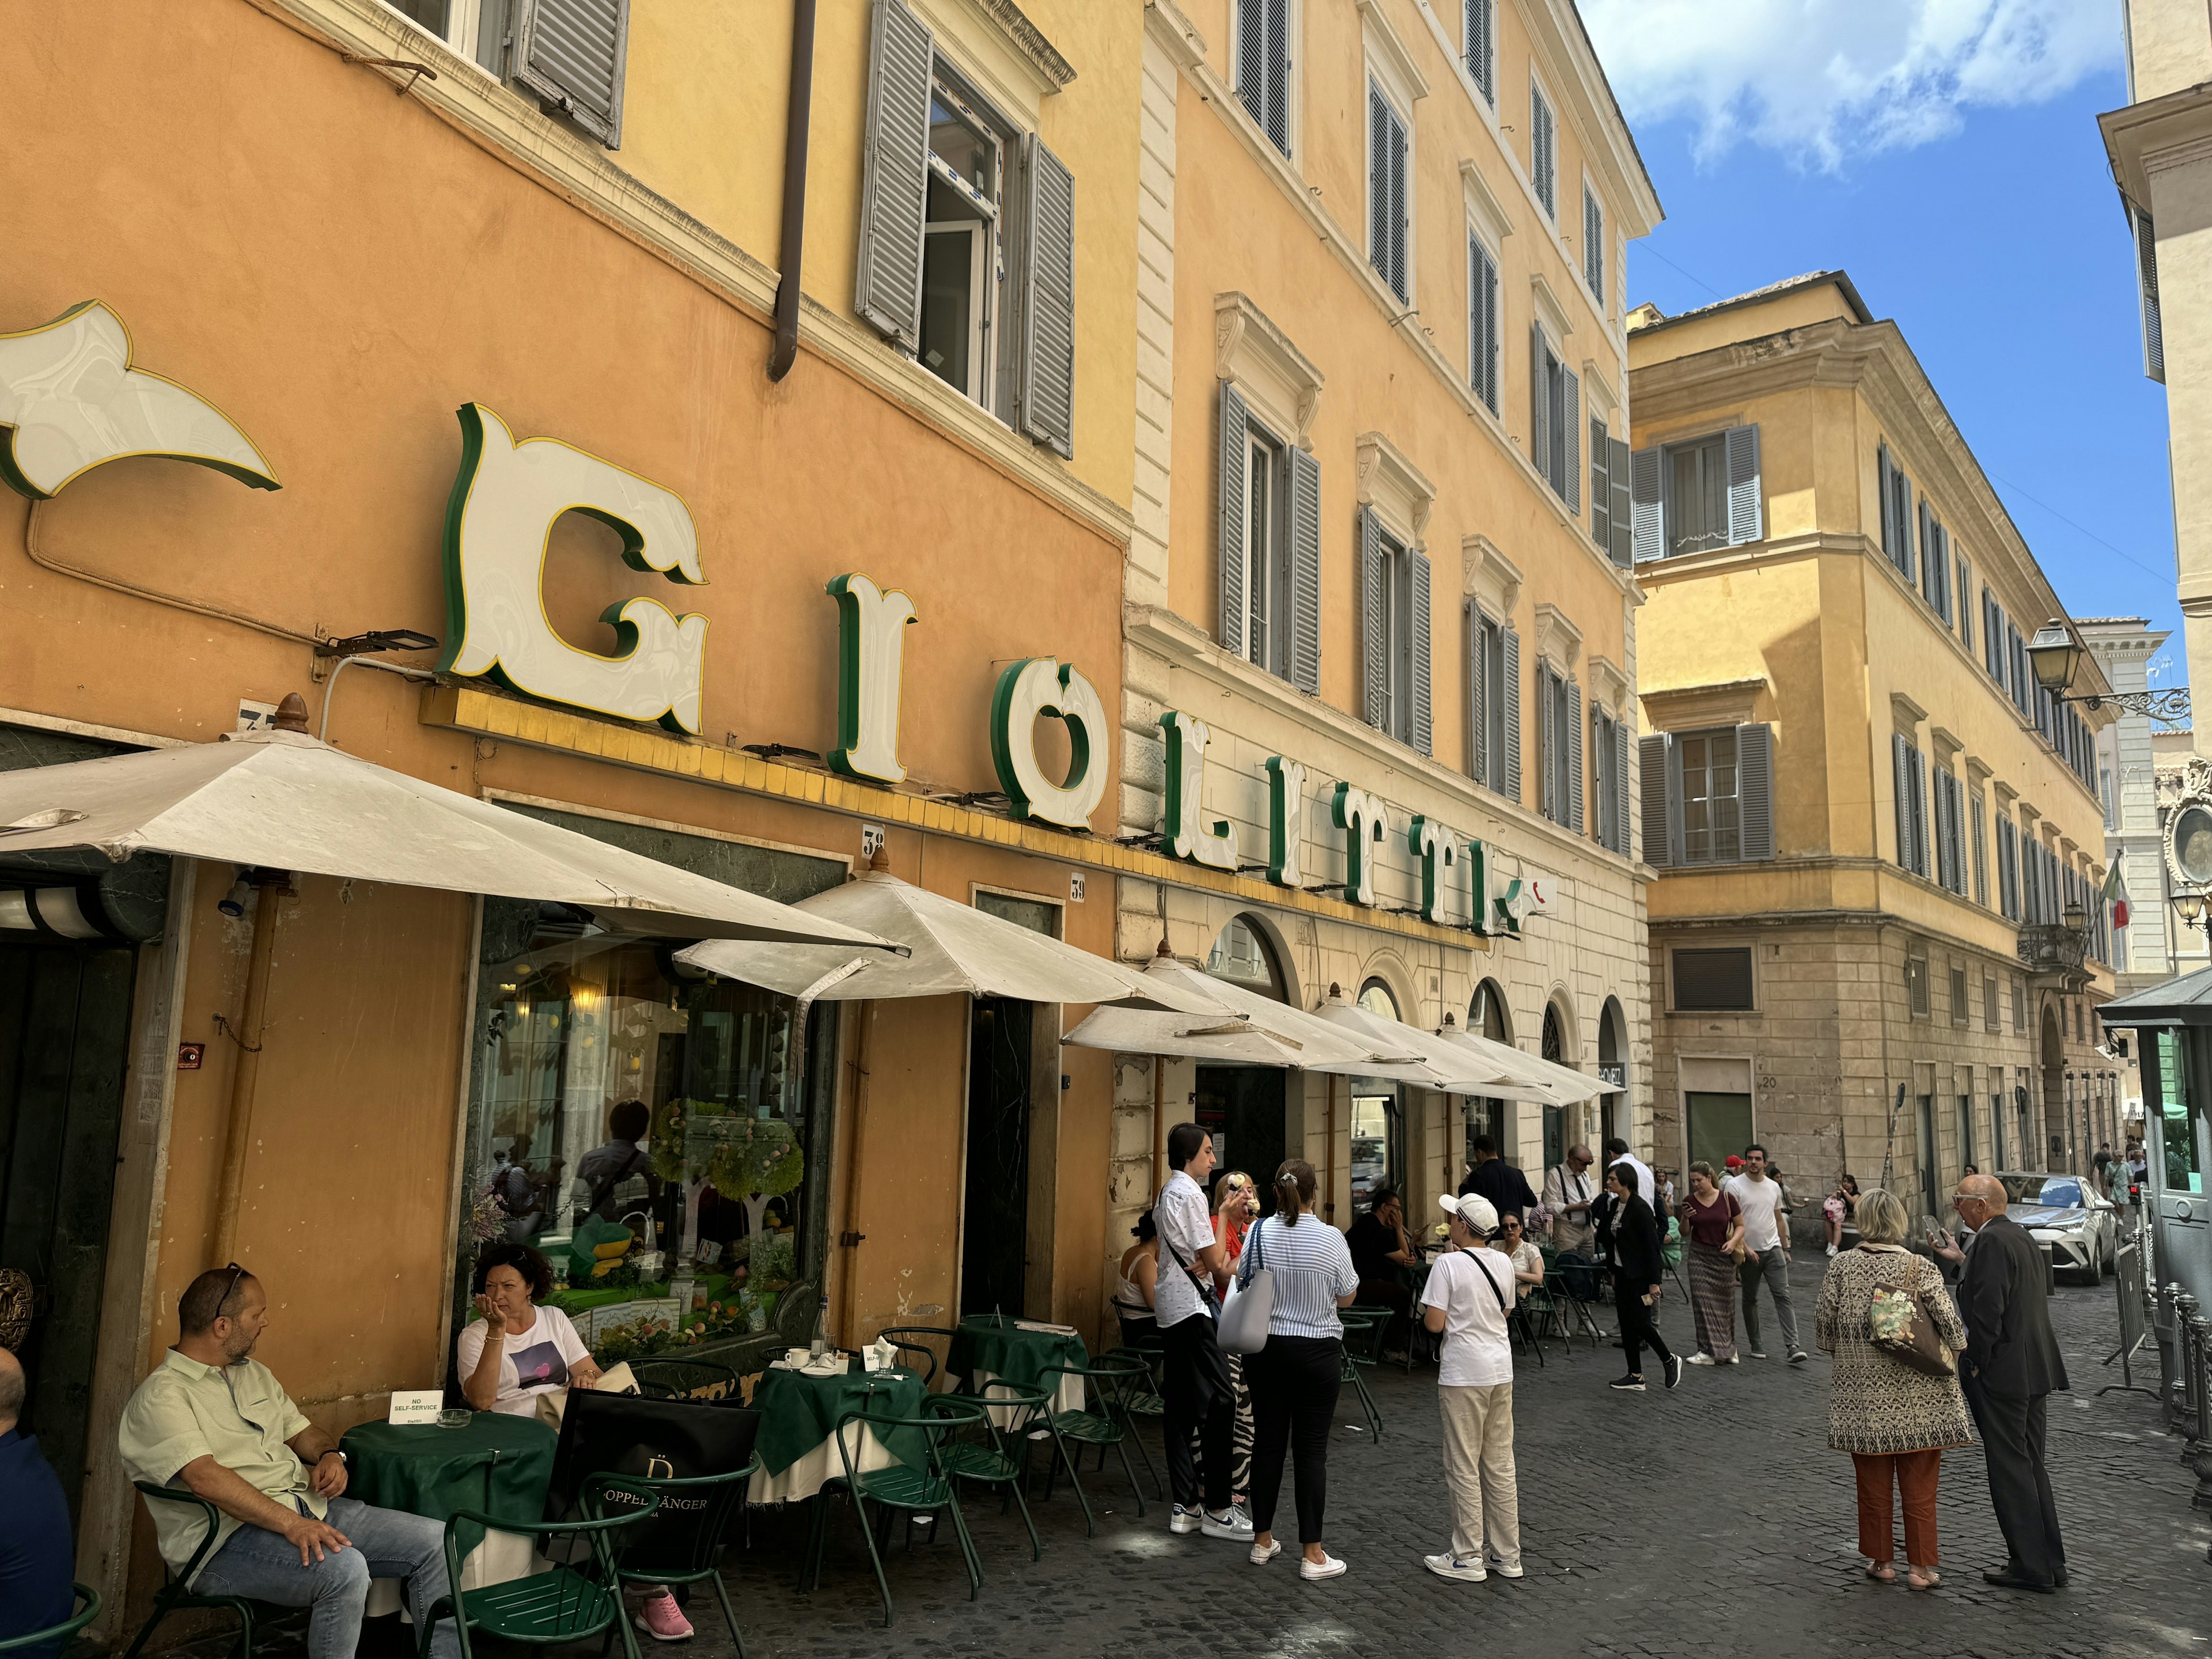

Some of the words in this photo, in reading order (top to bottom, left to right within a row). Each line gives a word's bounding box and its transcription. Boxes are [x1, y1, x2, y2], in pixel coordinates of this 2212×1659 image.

[435, 402, 1495, 935] GIOLITTI
[864, 831, 883, 855] 38
[1072, 880, 1084, 899] 39
[1298, 924, 1309, 940] 40
[1763, 1076, 1777, 1088] 20
[603, 1490, 708, 1510] OPPELÄNGER
